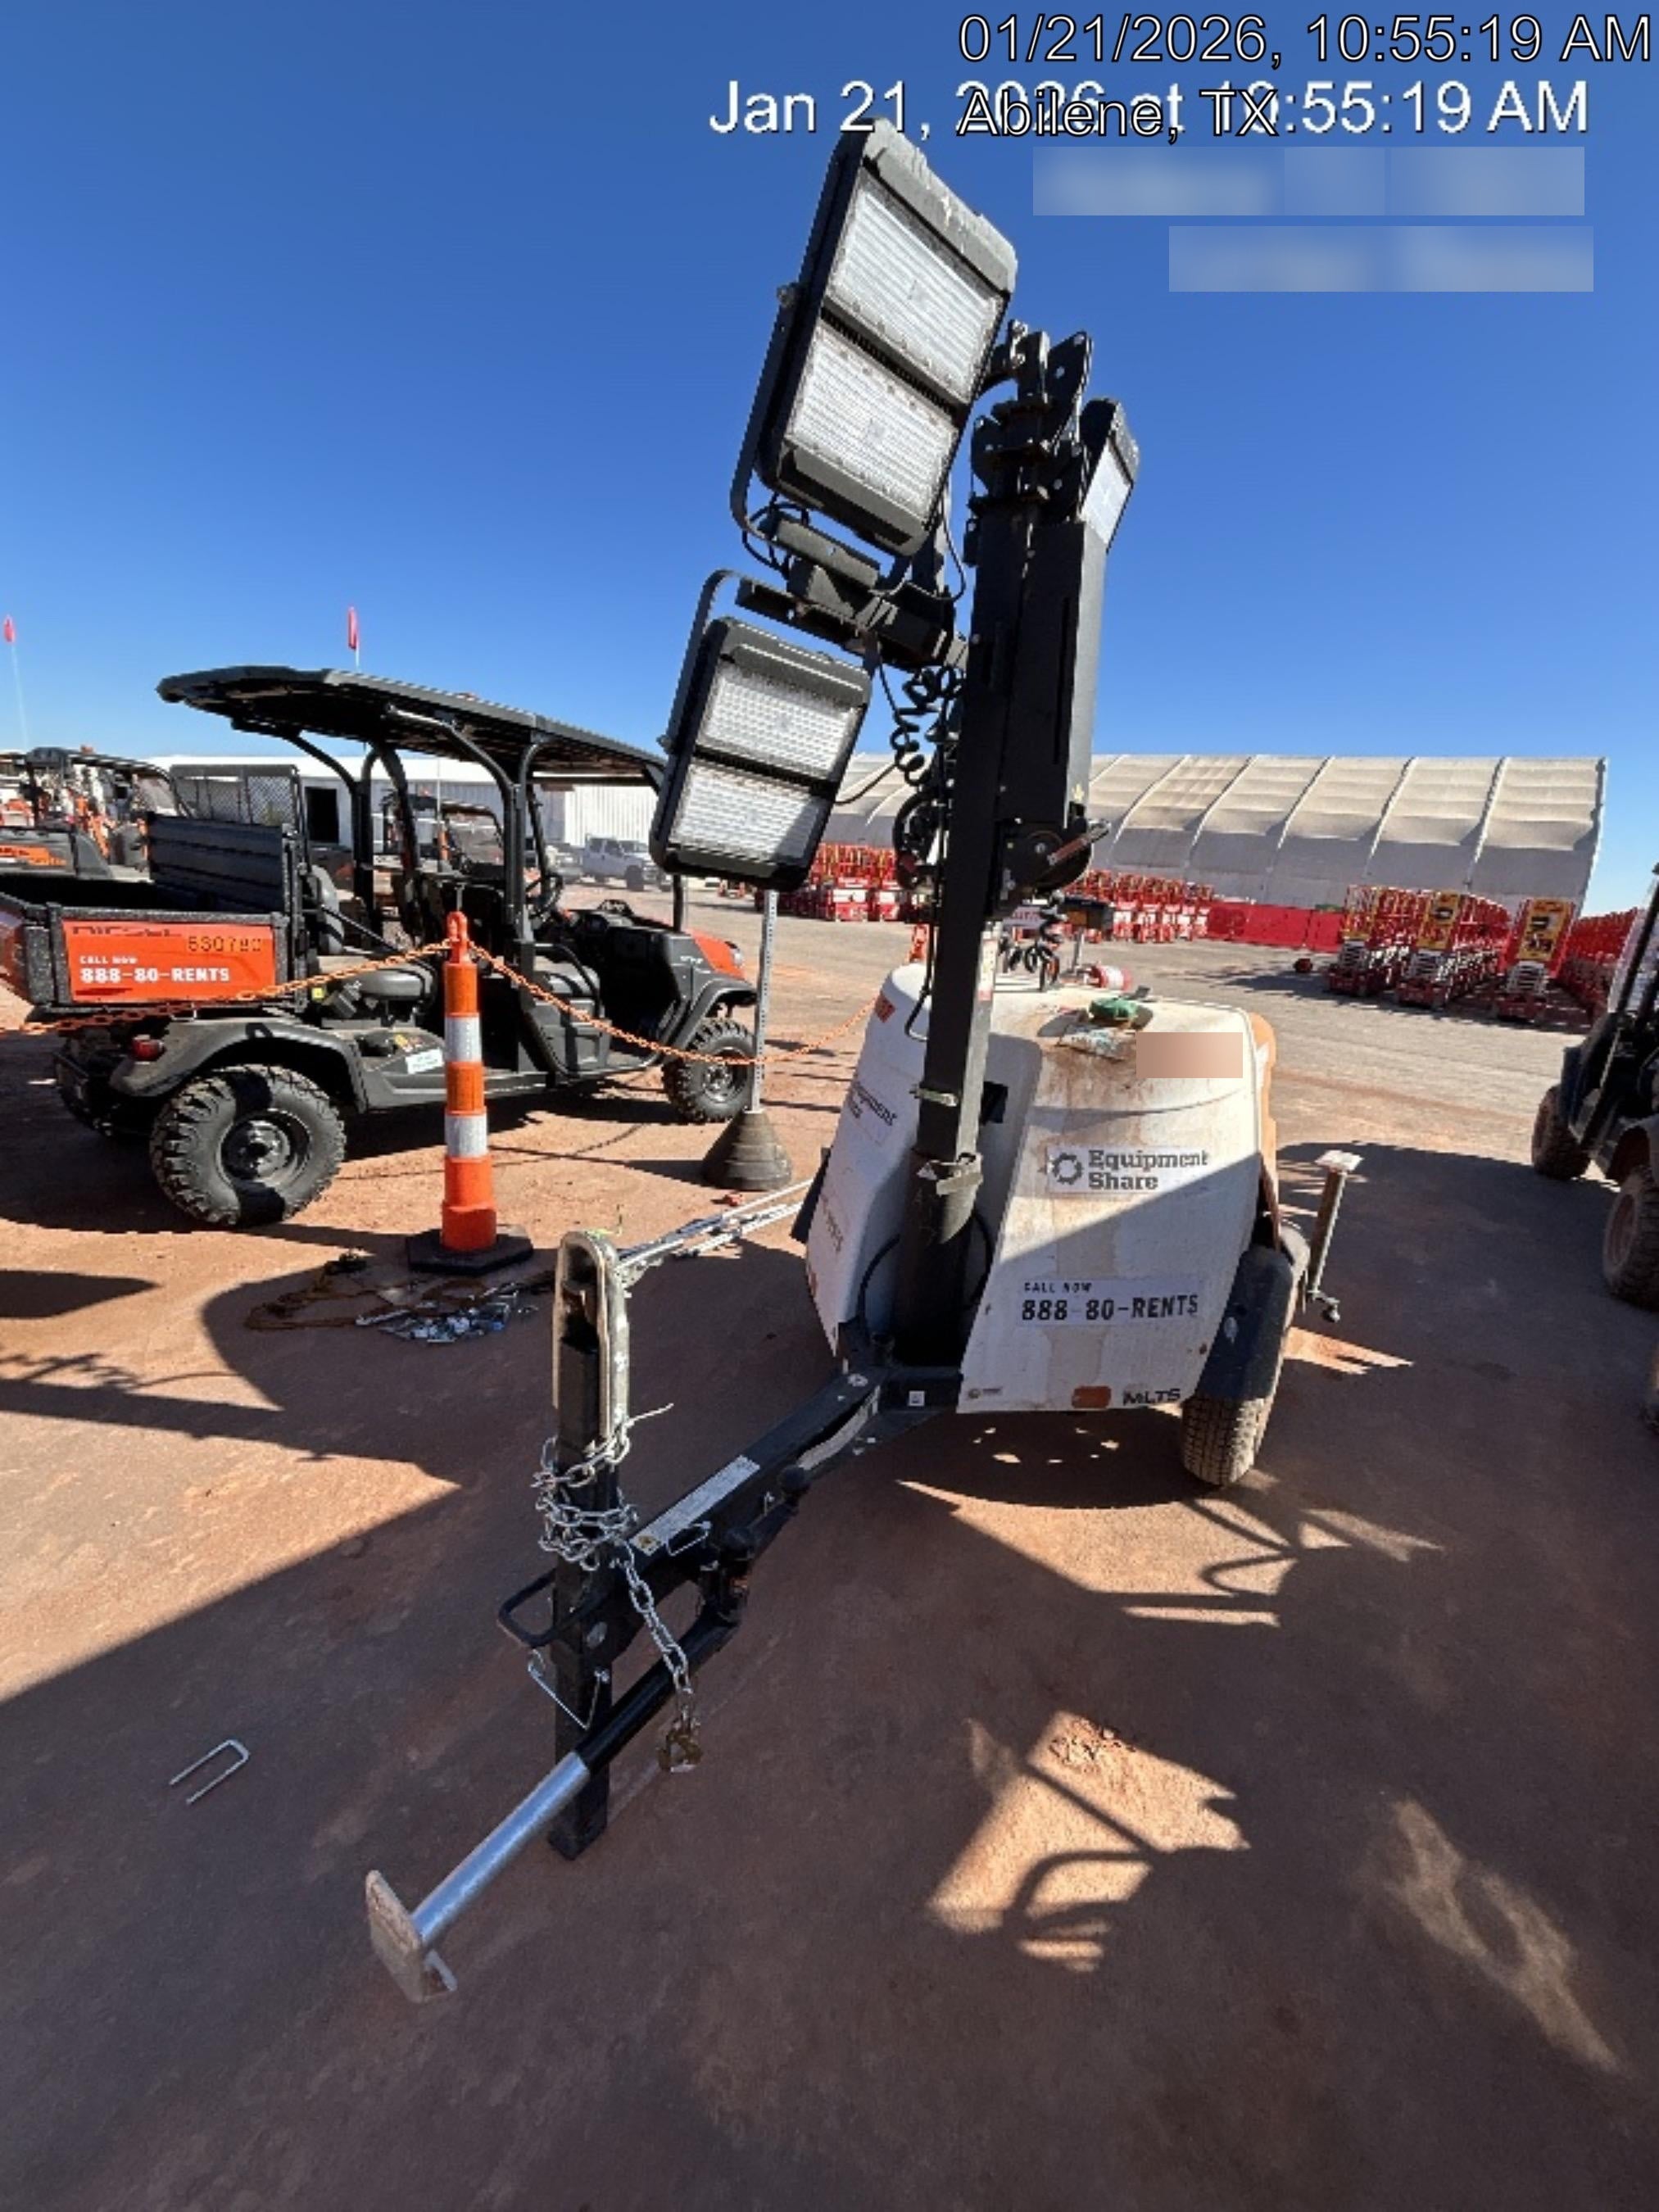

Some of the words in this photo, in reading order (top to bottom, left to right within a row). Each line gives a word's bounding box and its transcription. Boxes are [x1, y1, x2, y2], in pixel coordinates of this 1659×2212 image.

[79, 955, 109, 965] CALL
[79, 967, 230, 983] 888-80-RENTS
[1088, 1149, 1208, 1172] Equipment
[1088, 1172, 1159, 1190] Share
